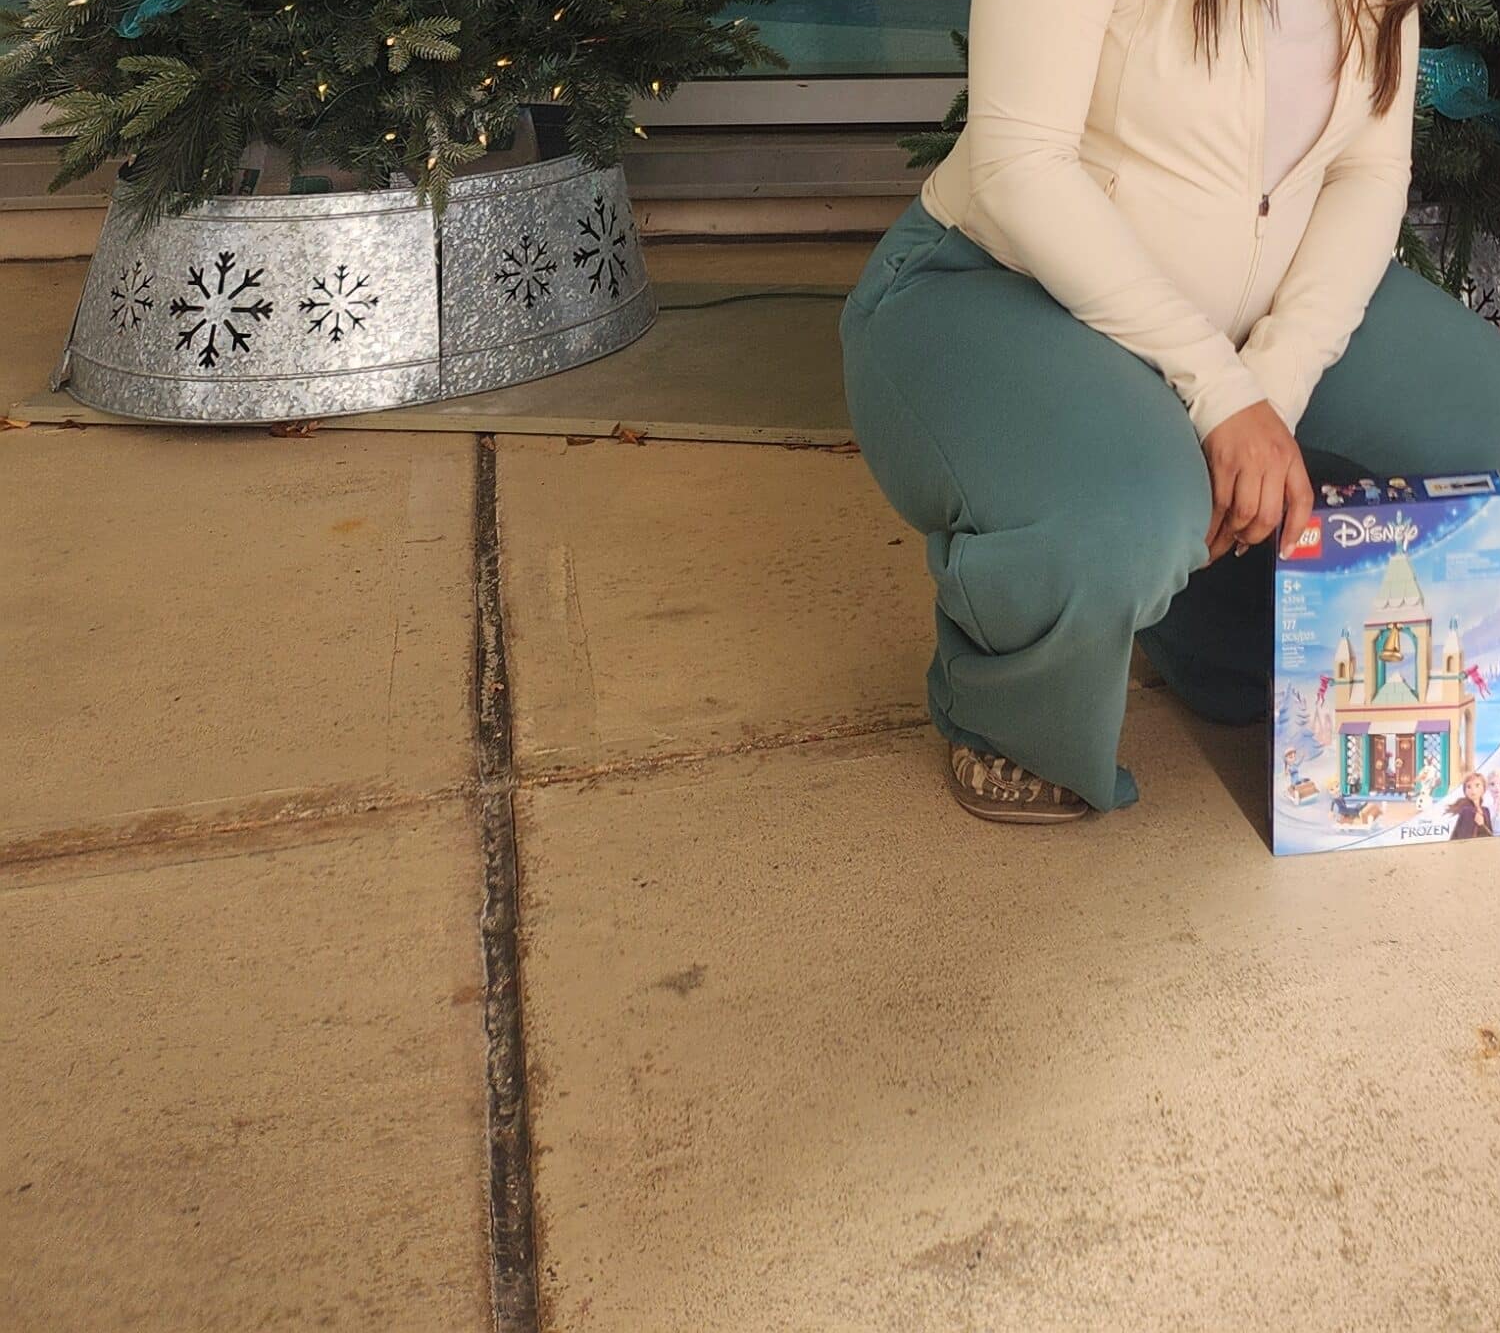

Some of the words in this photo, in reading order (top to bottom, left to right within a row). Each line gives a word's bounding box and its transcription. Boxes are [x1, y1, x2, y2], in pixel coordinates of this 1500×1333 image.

[1328, 513, 1419, 551] Disney
[1283, 580, 1302, 594] 5+
[1400, 824, 1450, 840] FROZEN
